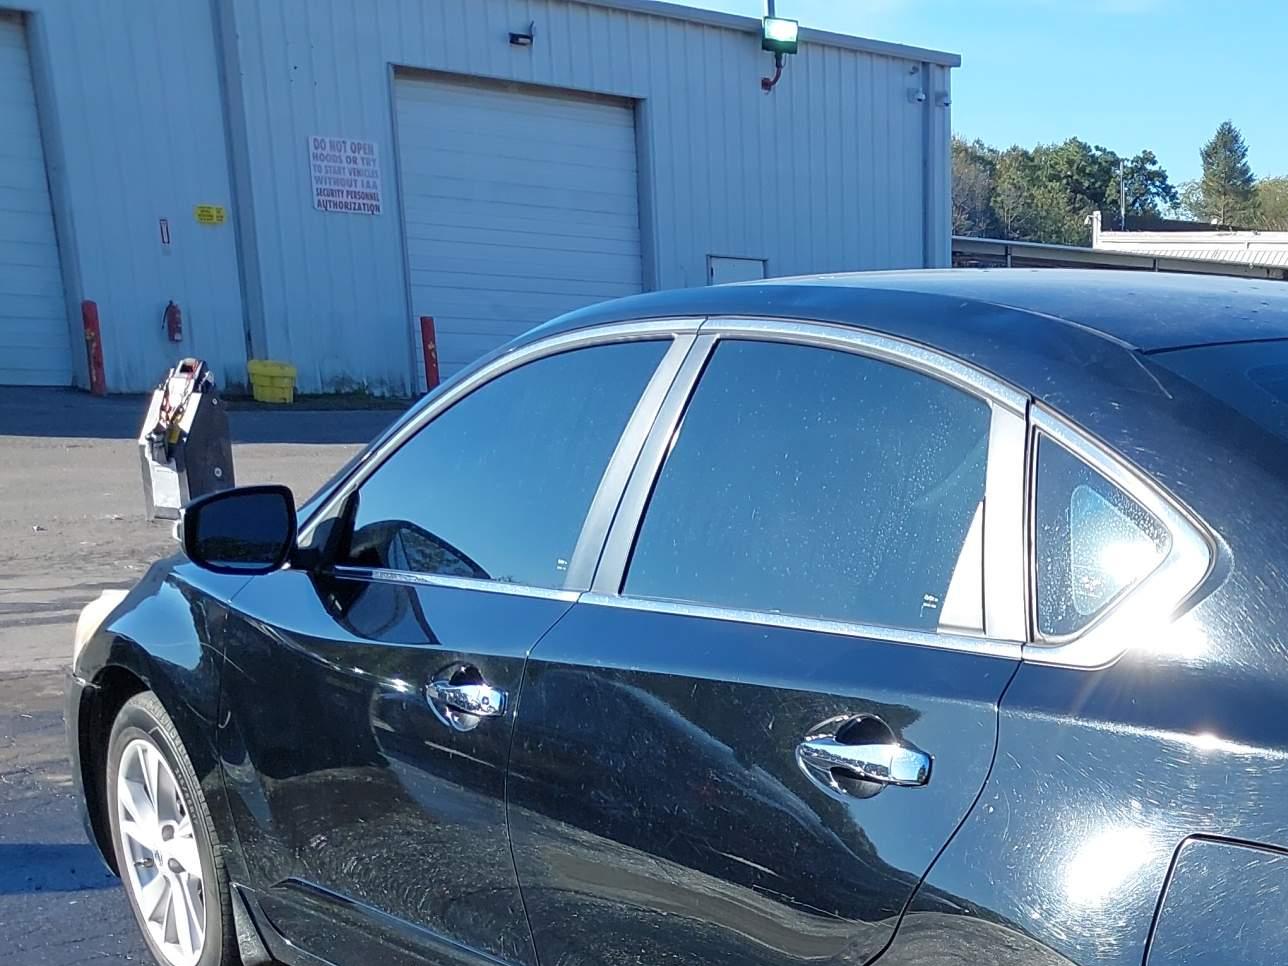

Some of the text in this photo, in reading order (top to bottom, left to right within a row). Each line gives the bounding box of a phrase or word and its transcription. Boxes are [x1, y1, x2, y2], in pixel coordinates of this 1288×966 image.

[313, 138, 374, 155] DO NOT OPEN
[345, 155, 358, 165] OR
[360, 157, 376, 167] TRY
[312, 164, 323, 174] TO
[324, 165, 346, 175] START
[314, 176, 378, 190] WITHOUT IAA
[316, 187, 380, 202] SECURITY PERSONNEL
[317, 199, 381, 213] AUTHORIZATION
